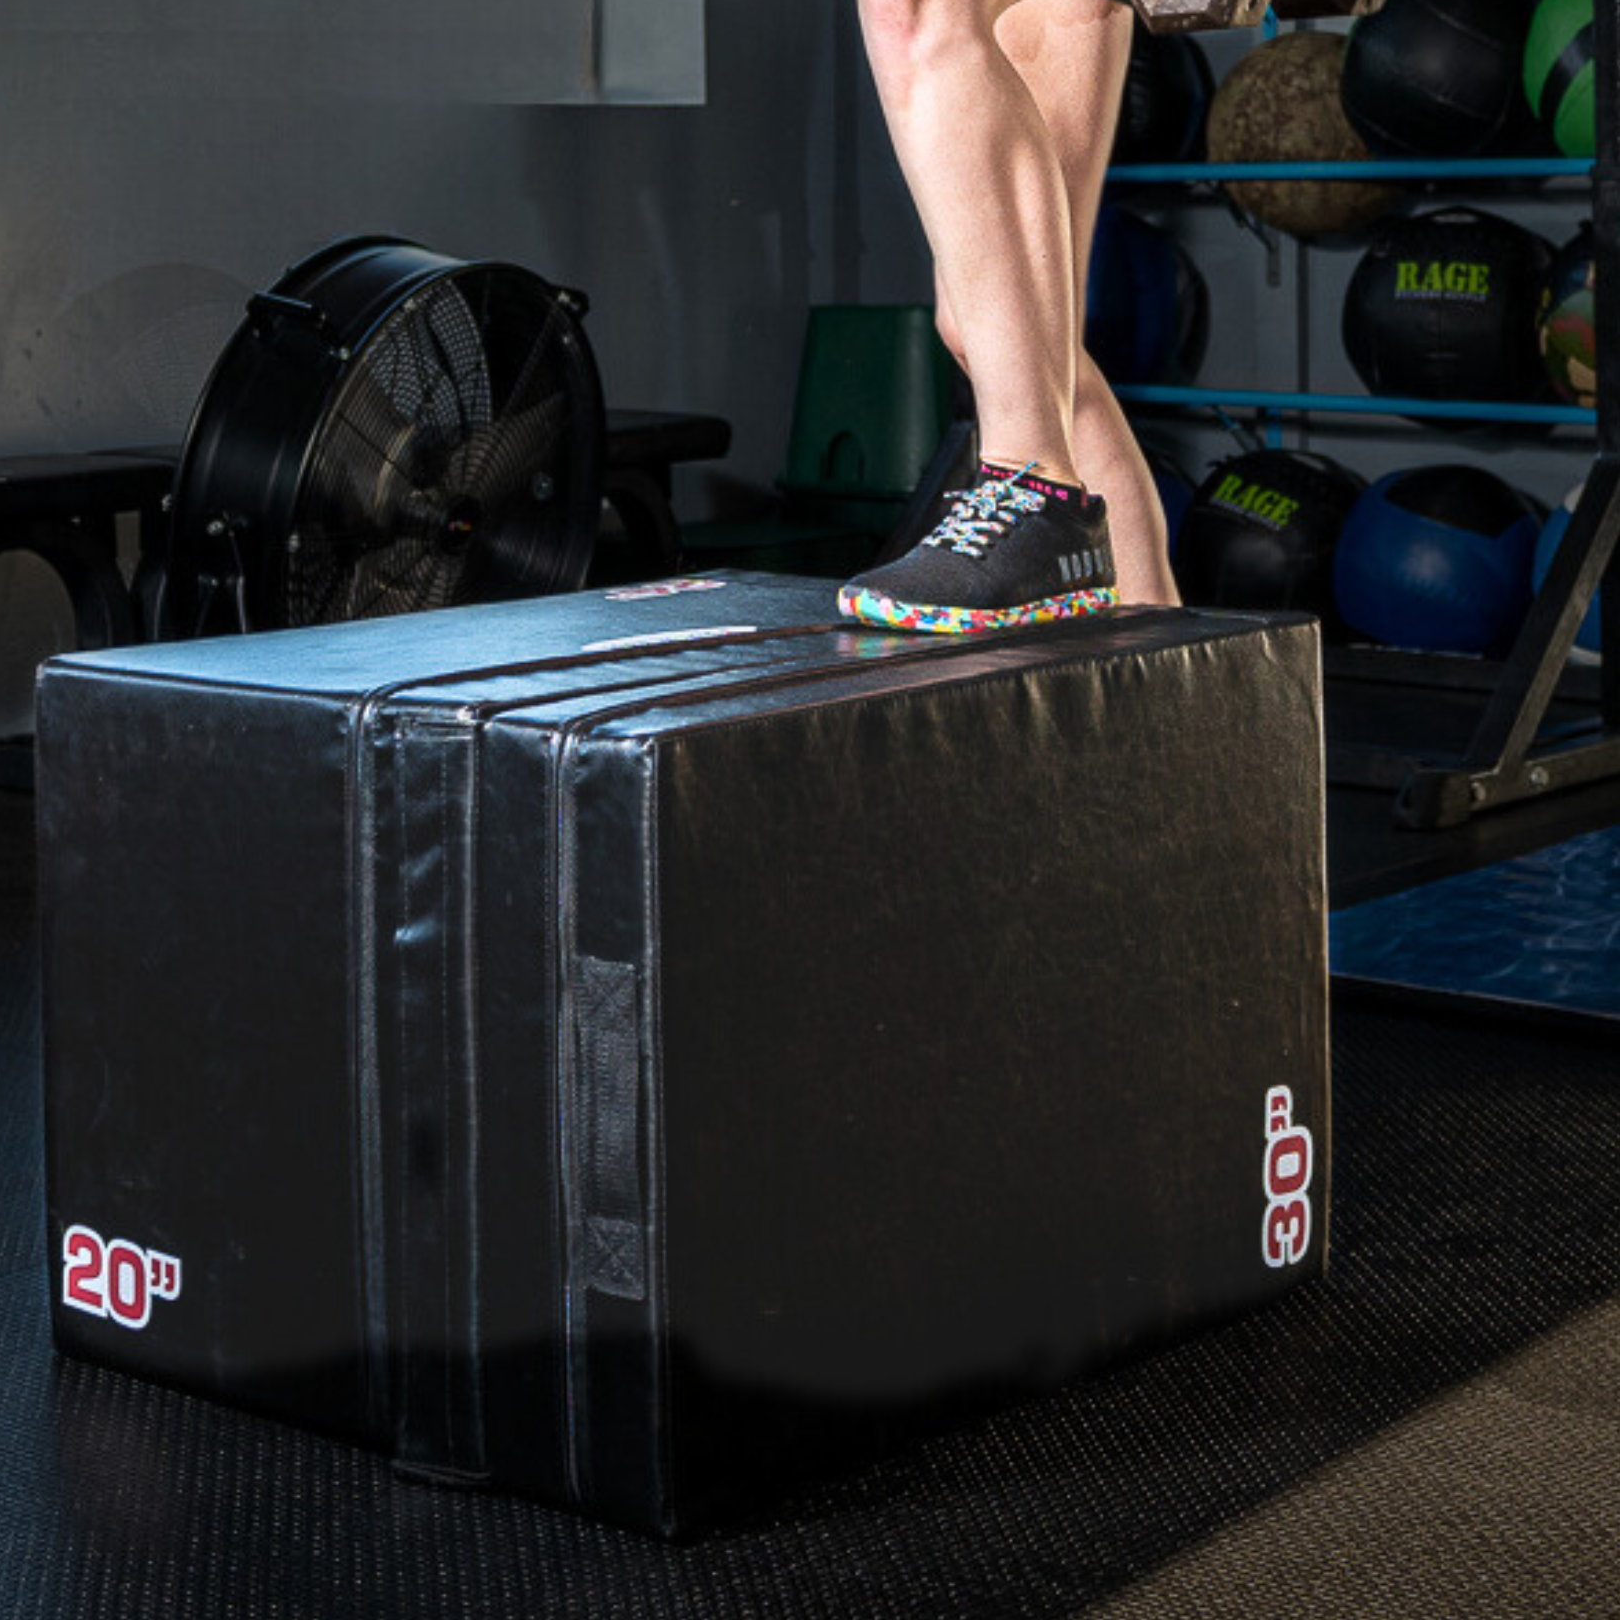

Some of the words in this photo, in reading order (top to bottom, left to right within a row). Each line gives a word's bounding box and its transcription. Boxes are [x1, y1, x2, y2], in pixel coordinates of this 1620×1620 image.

[1396, 261, 1491, 294] RAGE
[1216, 474, 1300, 525] RAGE
[1264, 1089, 1311, 1265] 30"
[64, 1228, 180, 1326] 20"
